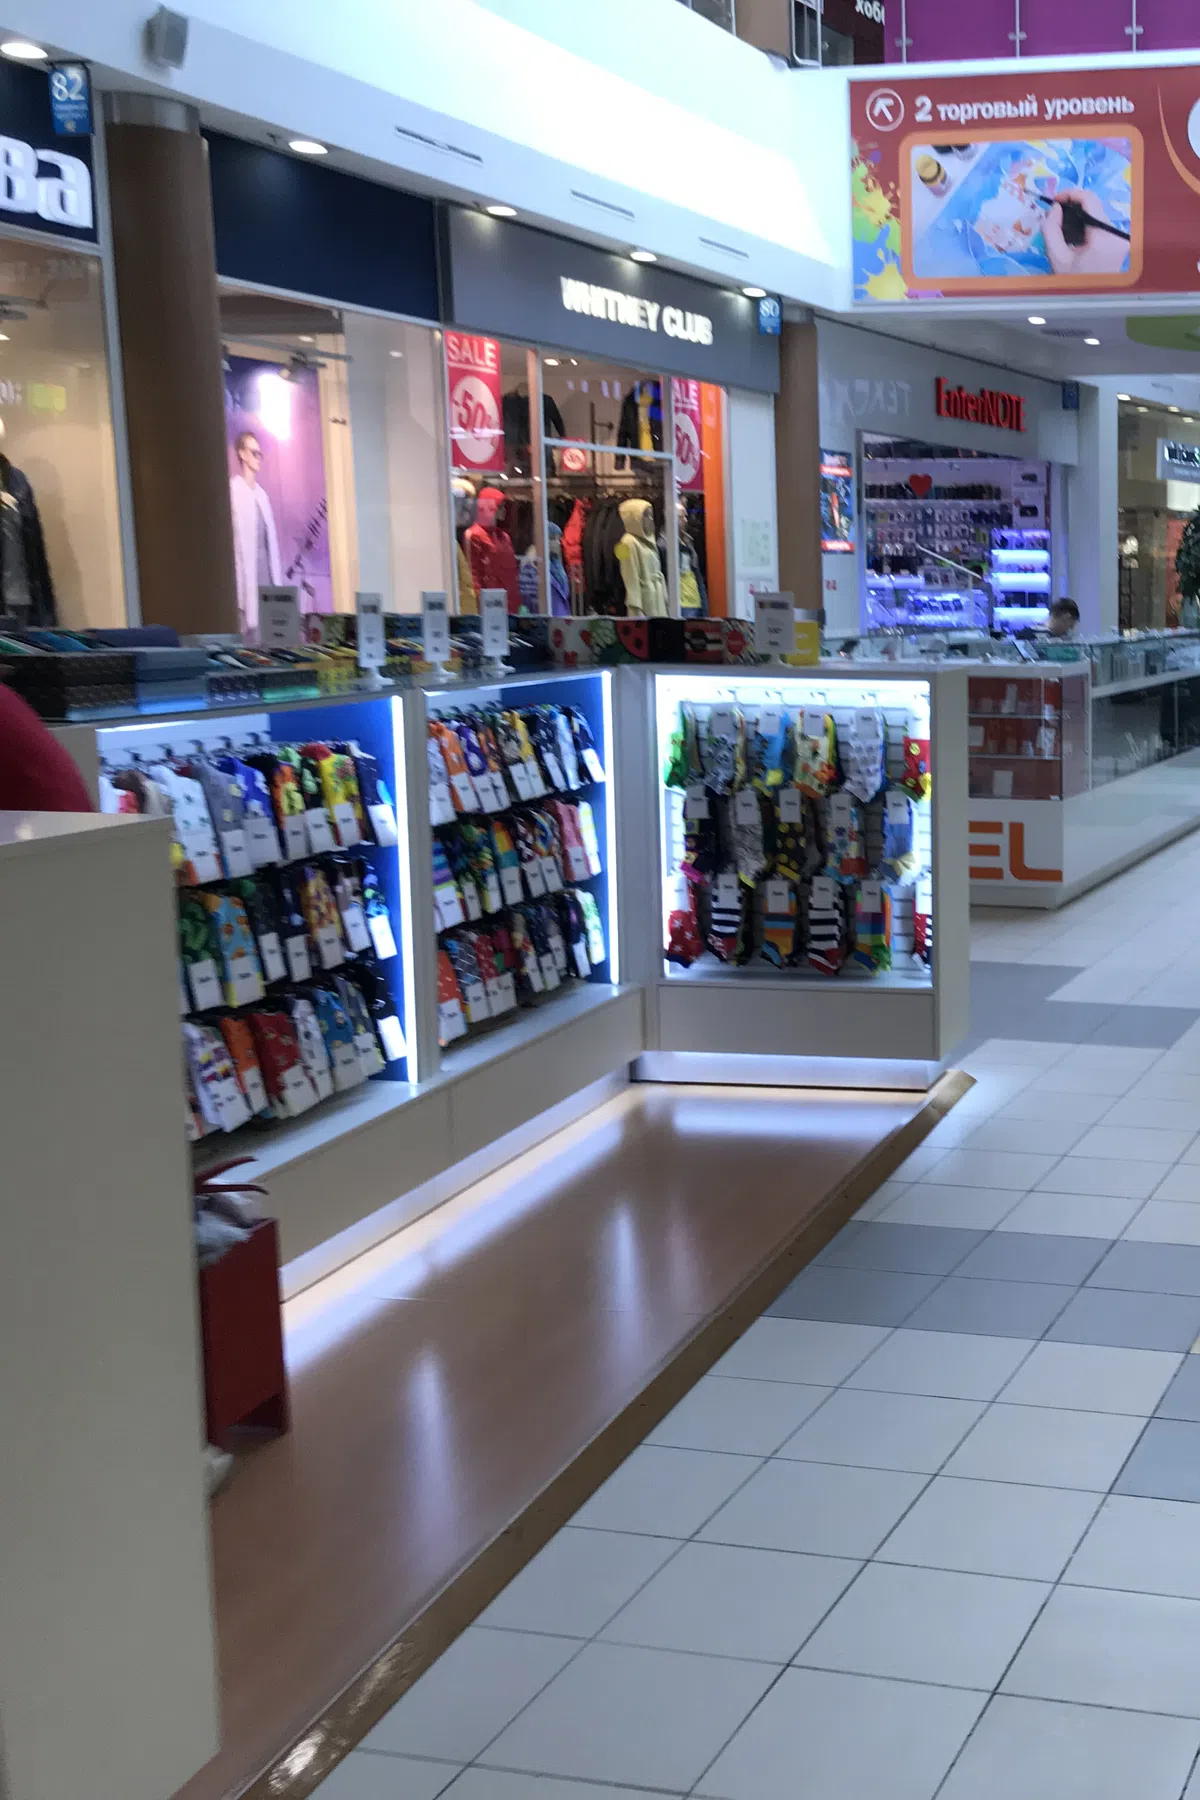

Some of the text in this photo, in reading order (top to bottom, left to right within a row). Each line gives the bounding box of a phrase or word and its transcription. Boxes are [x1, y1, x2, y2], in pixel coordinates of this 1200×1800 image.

[52, 69, 86, 102] 82
[915, 94, 1135, 125] 2 торговый уровень
[662, 305, 714, 345] CLUB
[447, 334, 498, 368] SALE
